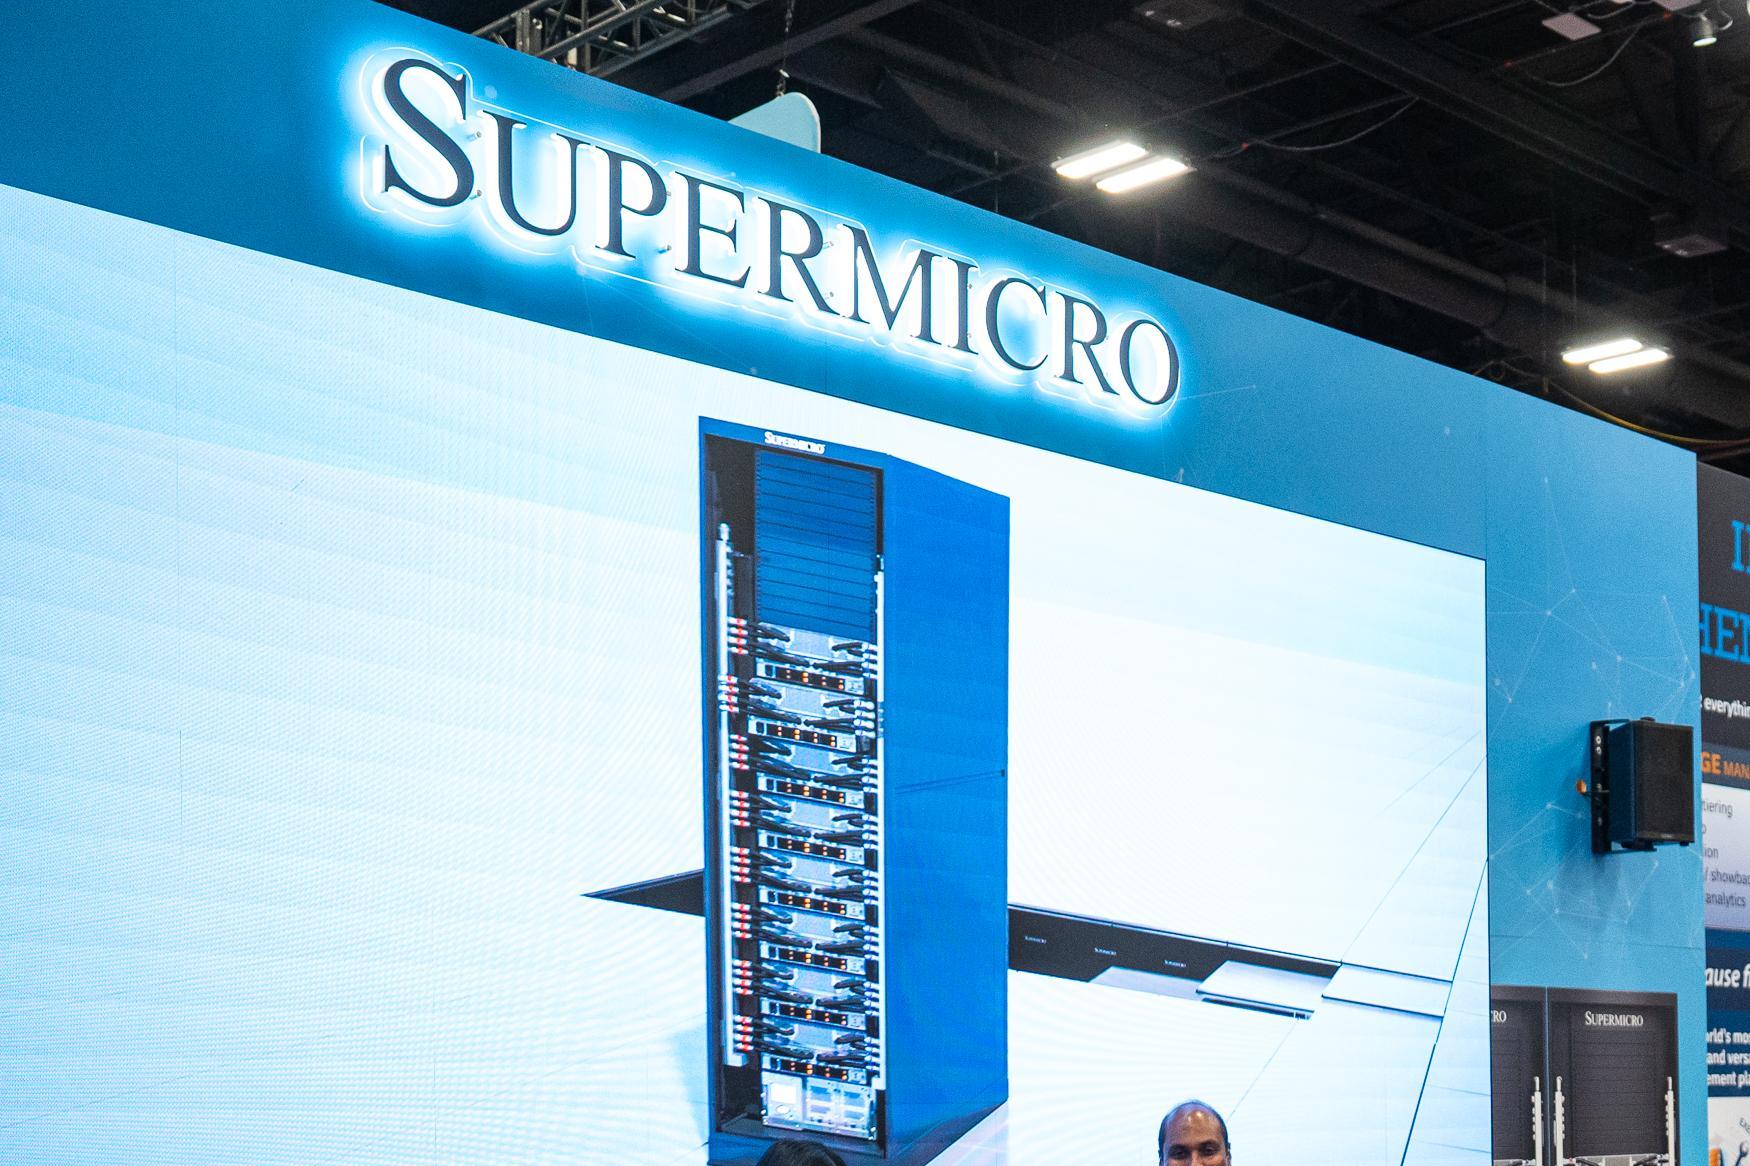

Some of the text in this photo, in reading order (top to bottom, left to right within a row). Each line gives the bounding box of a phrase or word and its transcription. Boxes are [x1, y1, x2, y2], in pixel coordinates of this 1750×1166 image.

[382, 57, 1180, 407] SUPERMICRO
[1706, 892, 1746, 908] analytics
[1705, 967, 1740, 987] ause
[1585, 1011, 1643, 1027] SUPERMICRO
[1706, 1028, 1731, 1045] orld's
[1707, 1071, 1736, 1086] ement
